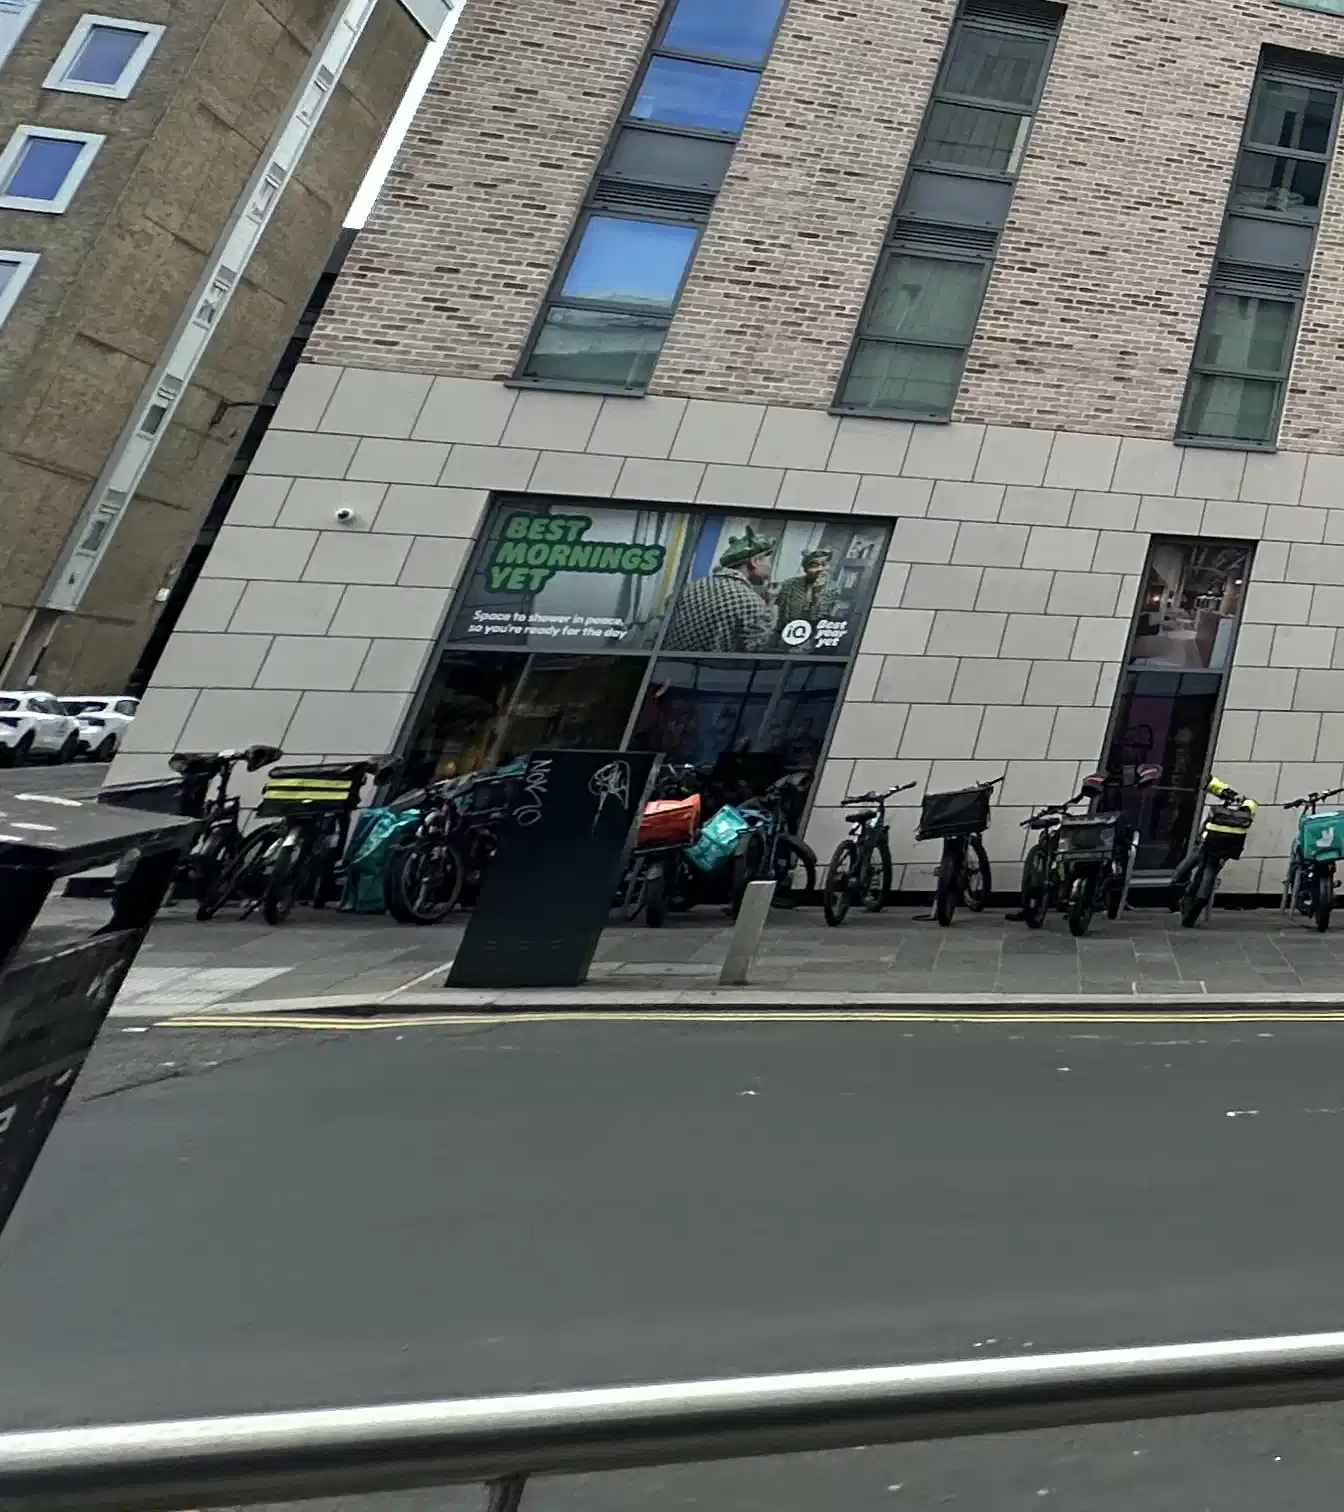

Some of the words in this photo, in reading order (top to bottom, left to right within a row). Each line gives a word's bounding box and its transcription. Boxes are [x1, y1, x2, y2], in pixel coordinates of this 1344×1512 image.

[506, 516, 586, 541] BEST
[496, 542, 661, 571] MORNINGS
[490, 566, 549, 591] YET
[473, 610, 511, 623] Space
[513, 612, 526, 622] to
[528, 613, 572, 623] shower
[572, 614, 584, 624] in
[468, 624, 483, 633] so
[484, 624, 521, 635] you're
[523, 625, 560, 637] ready
[562, 626, 581, 636] for
[582, 627, 602, 637] the
[604, 628, 628, 639] day
[786, 625, 806, 639] iQ
